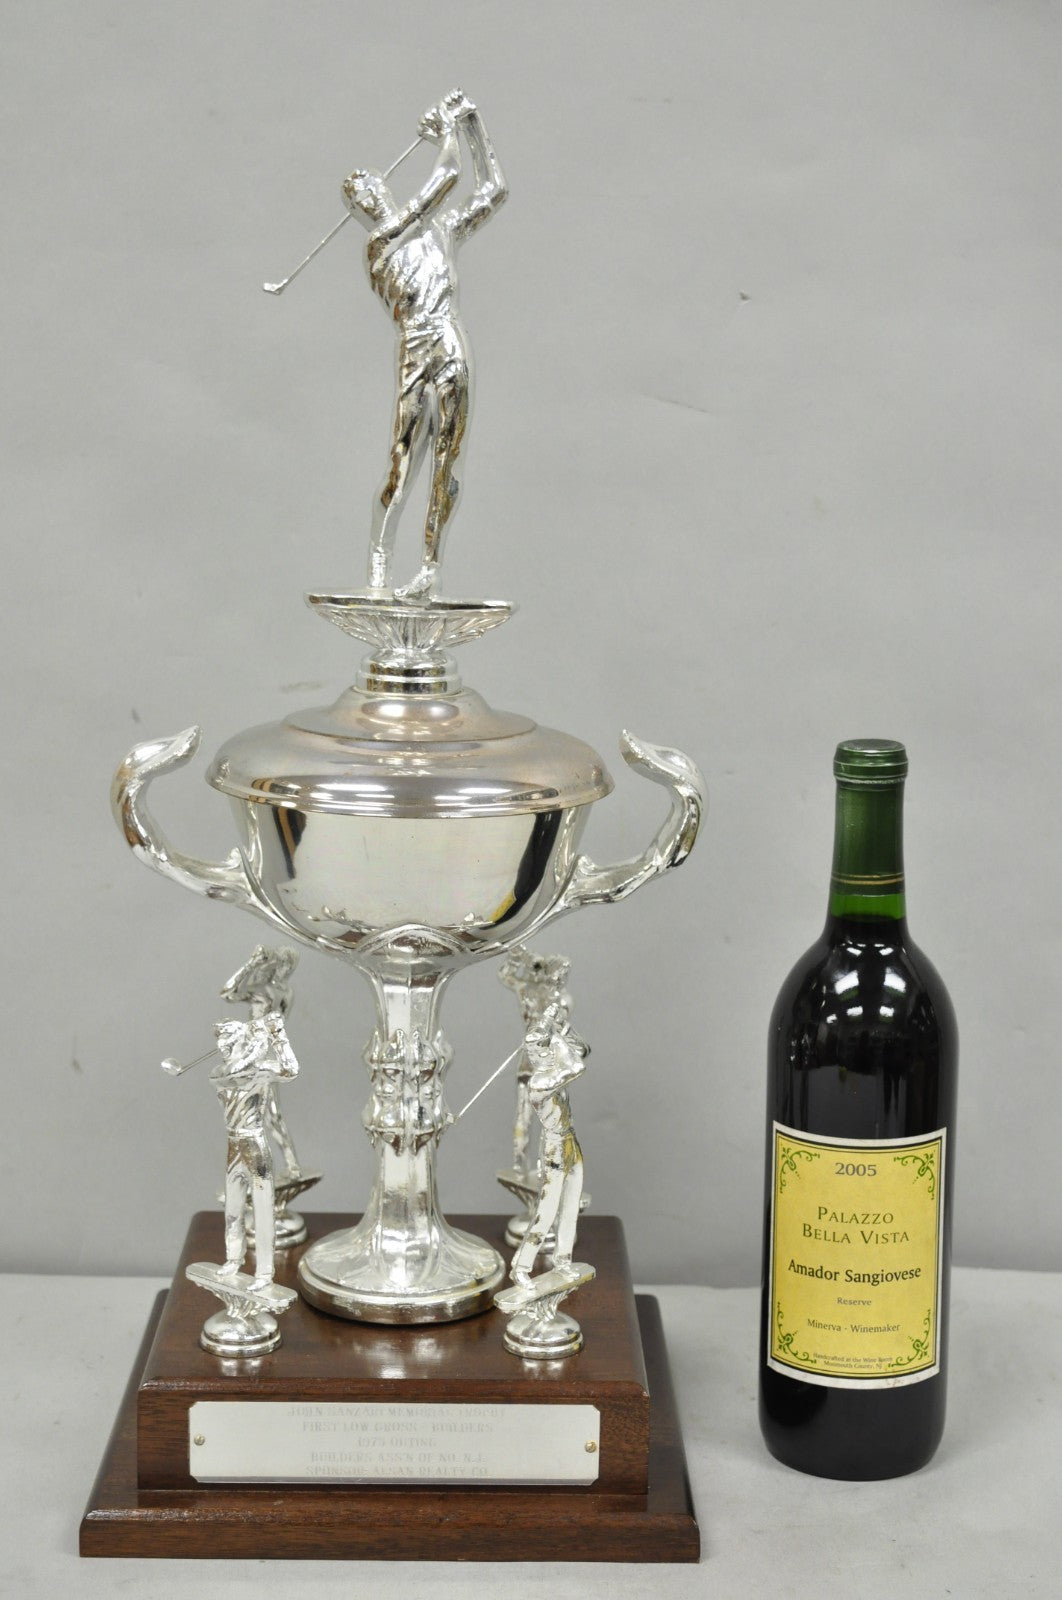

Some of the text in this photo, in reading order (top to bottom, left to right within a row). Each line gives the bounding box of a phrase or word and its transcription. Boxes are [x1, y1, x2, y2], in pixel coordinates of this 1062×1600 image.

[835, 1162, 877, 1177] 2005
[817, 1206, 894, 1225] PALAZZO
[802, 1223, 910, 1244] BELLA VISTA
[788, 1259, 921, 1286] Amador Sangiovese
[837, 1297, 872, 1306] Reserve
[807, 1318, 841, 1332] Minerva
[851, 1323, 900, 1333] Winemaker
[343, 1422, 368, 1432] LOW
